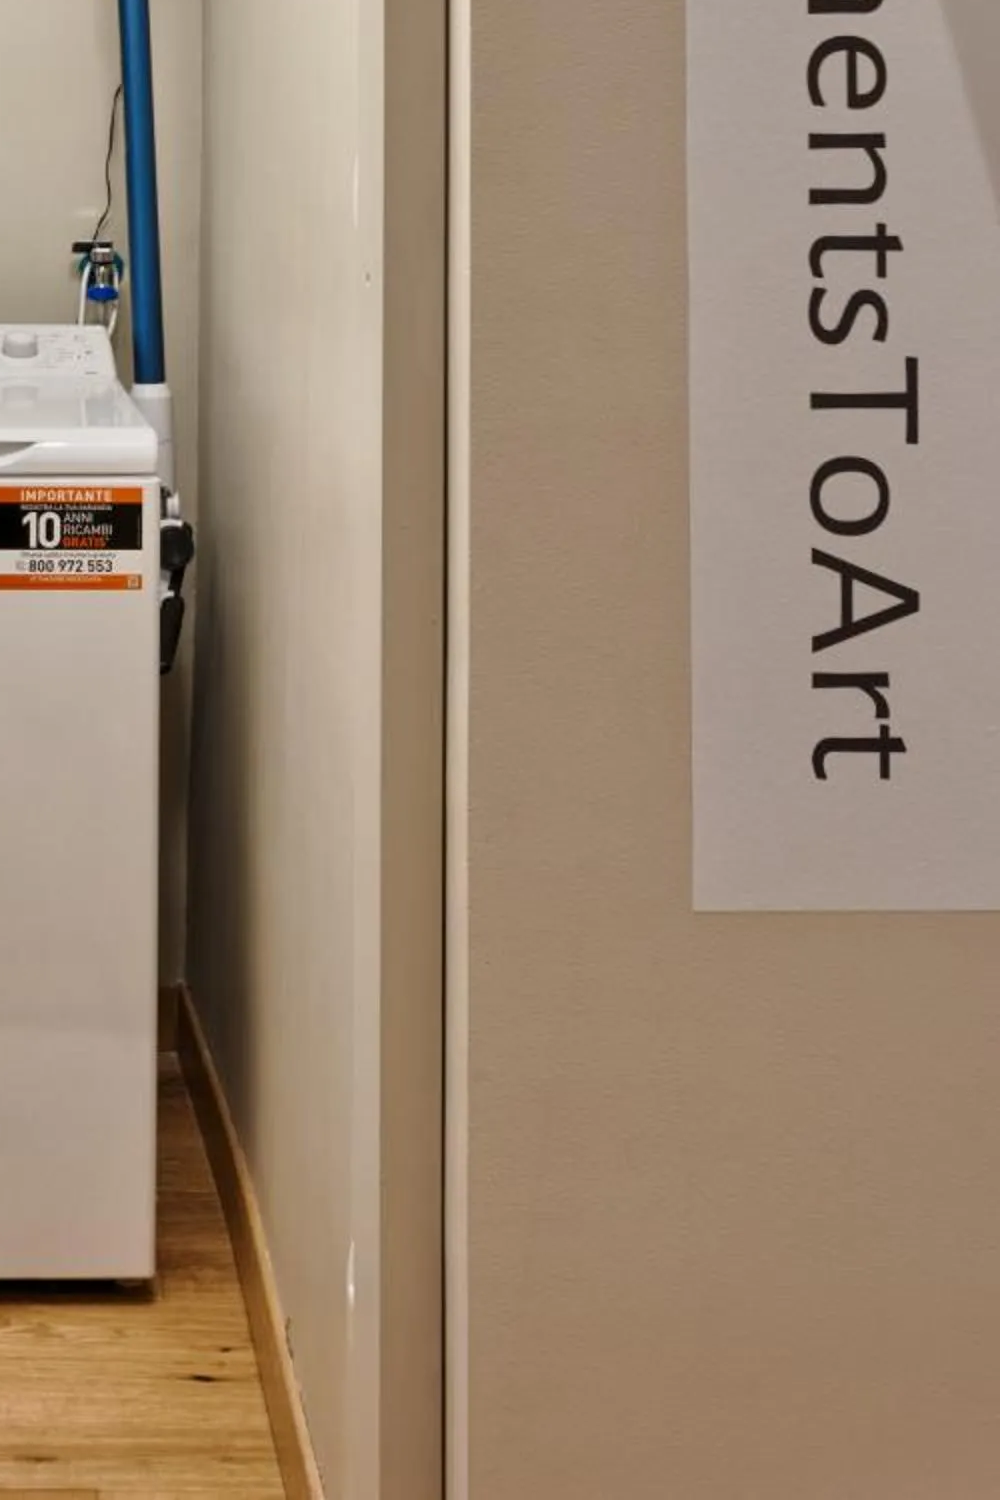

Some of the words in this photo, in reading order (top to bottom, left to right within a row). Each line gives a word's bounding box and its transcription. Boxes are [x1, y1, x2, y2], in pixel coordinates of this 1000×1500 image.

[20, 490, 113, 502] IMPORTANTE
[63, 512, 93, 523] ANNI
[21, 511, 62, 549] 10
[63, 524, 113, 535] RICAMBI
[28, 560, 55, 573] 800
[57, 560, 83, 573] 972
[87, 560, 113, 573] 553
